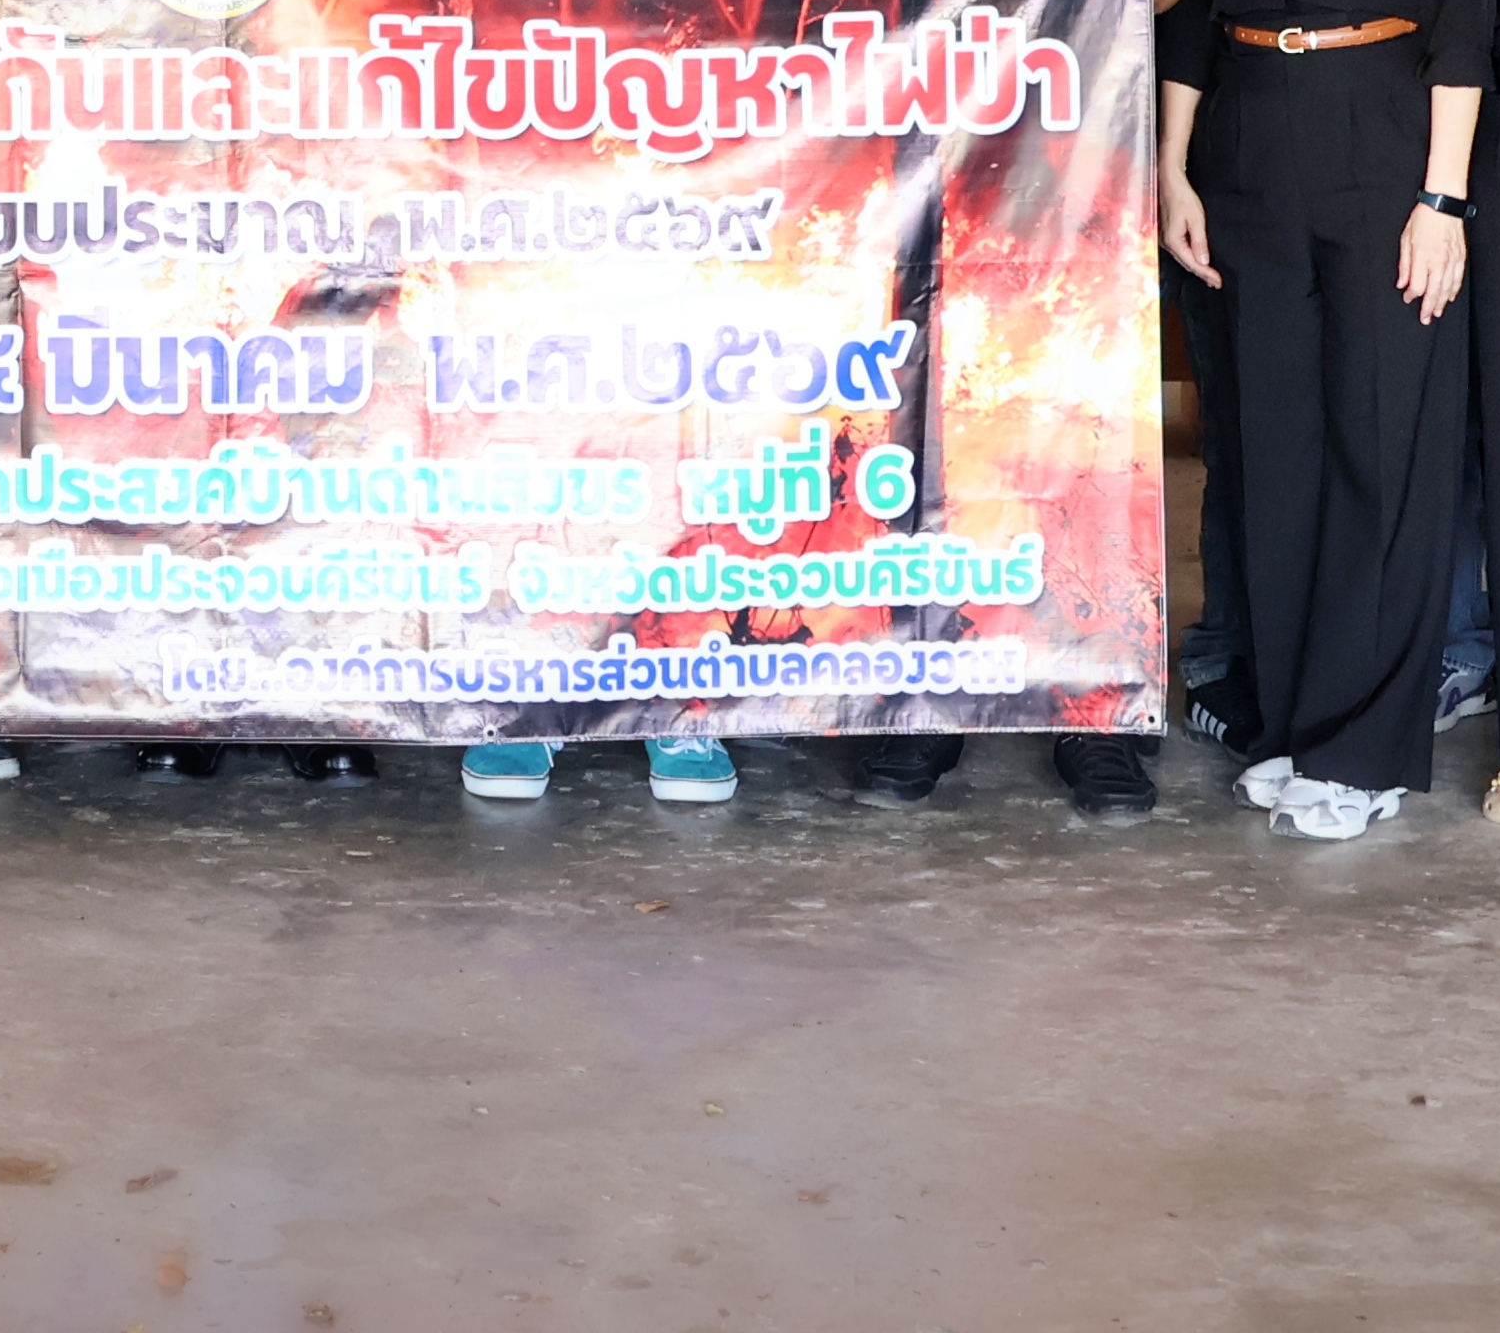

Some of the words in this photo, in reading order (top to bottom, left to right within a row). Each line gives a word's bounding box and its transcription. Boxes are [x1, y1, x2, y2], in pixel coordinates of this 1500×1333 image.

[402, 188, 776, 255] พ.ศ.๒๕๖๙
[45, 304, 366, 407] มีนาคม
[426, 323, 908, 406] พ.ศ.๒๕๖๙
[684, 426, 822, 534] หมู่ที่
[864, 453, 908, 511] 6
[515, 540, 1040, 605] จังหวัดประจวบคีรีขันธ์
